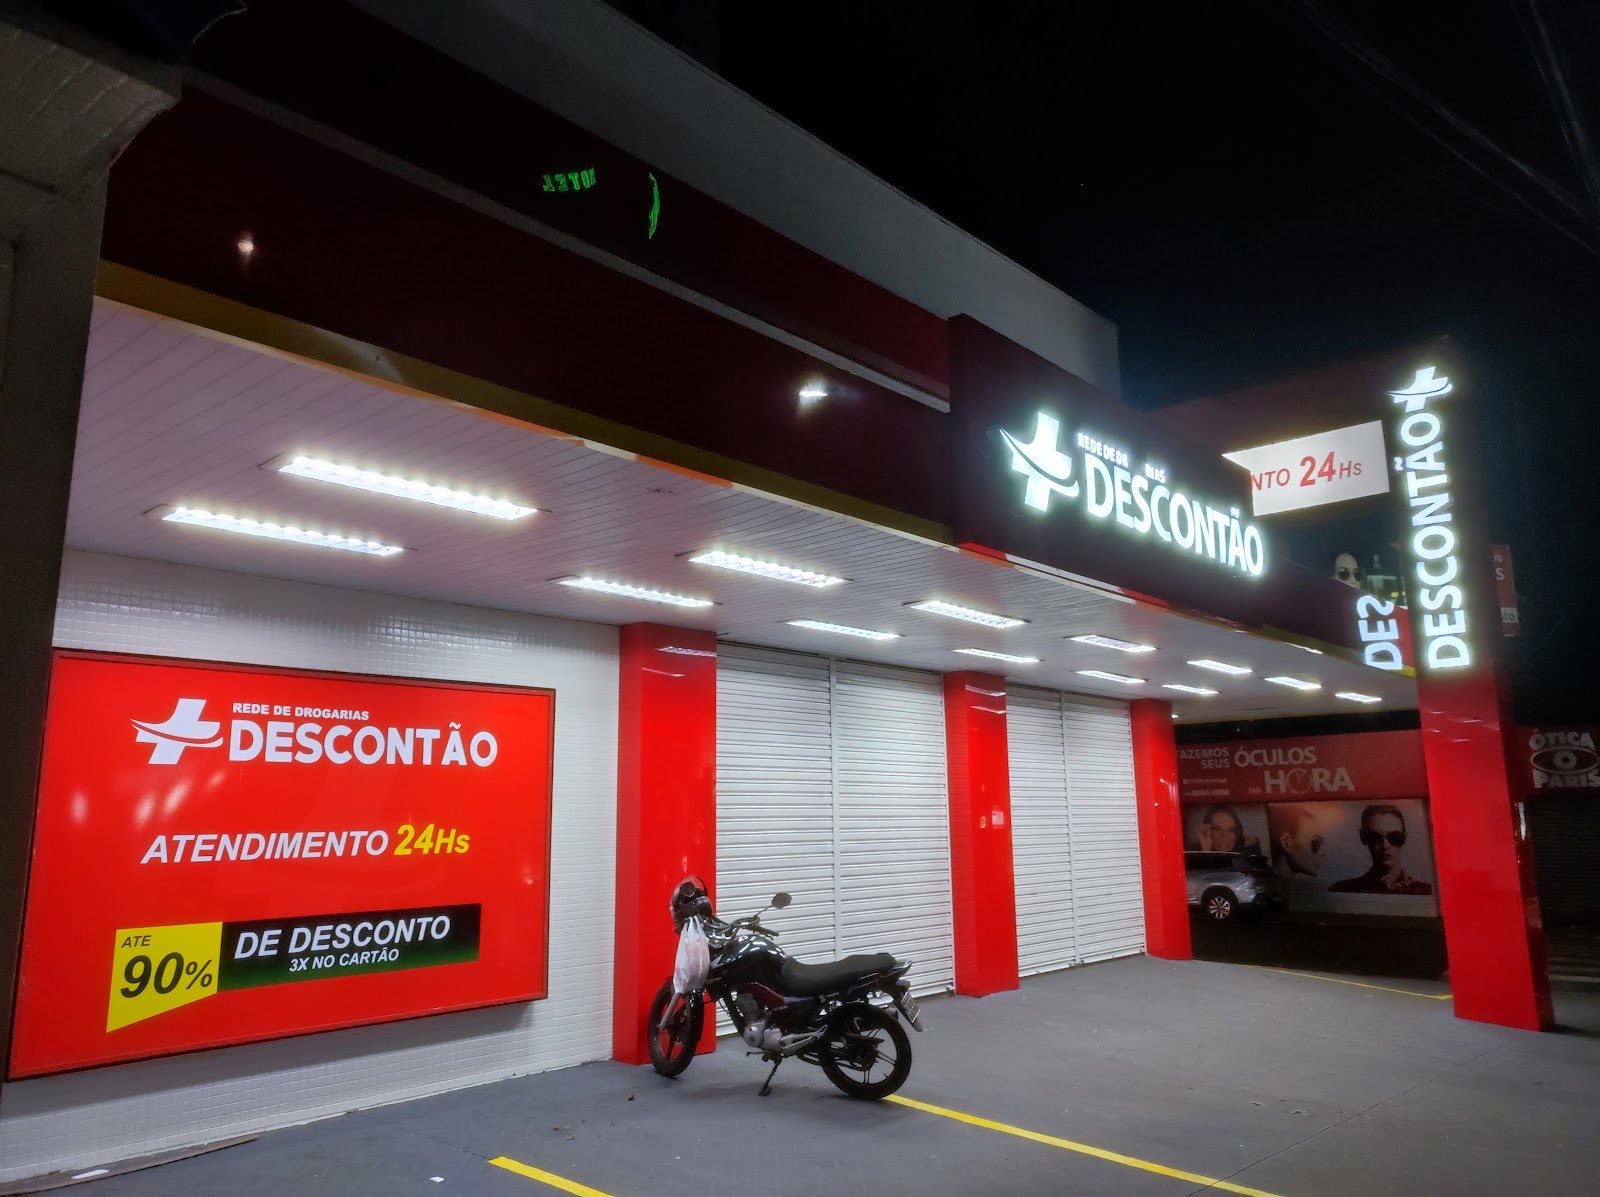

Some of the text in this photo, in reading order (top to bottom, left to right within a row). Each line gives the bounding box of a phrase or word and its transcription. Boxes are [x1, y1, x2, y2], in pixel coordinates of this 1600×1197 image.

[1077, 432, 1103, 456] REDE
[1103, 444, 1116, 463] DE
[1084, 453, 1264, 577] DESCONTÃO
[1394, 412, 1470, 669] DESCONTÃO
[232, 702, 370, 721] REDE DE DROGARIAS
[229, 719, 498, 768] DESCONTÃO
[1528, 728, 1597, 751] ÓTICA
[1200, 758, 1231, 770] SEUS
[1234, 745, 1318, 768] ÓCULOS
[1532, 768, 1600, 789] PARIS
[140, 830, 389, 864] ATENDIMENTO
[121, 935, 152, 949] ATE
[234, 915, 451, 960] DE DESCONTO
[289, 947, 399, 973] 3X NO CARTÃO
[120, 951, 213, 999] 90%
